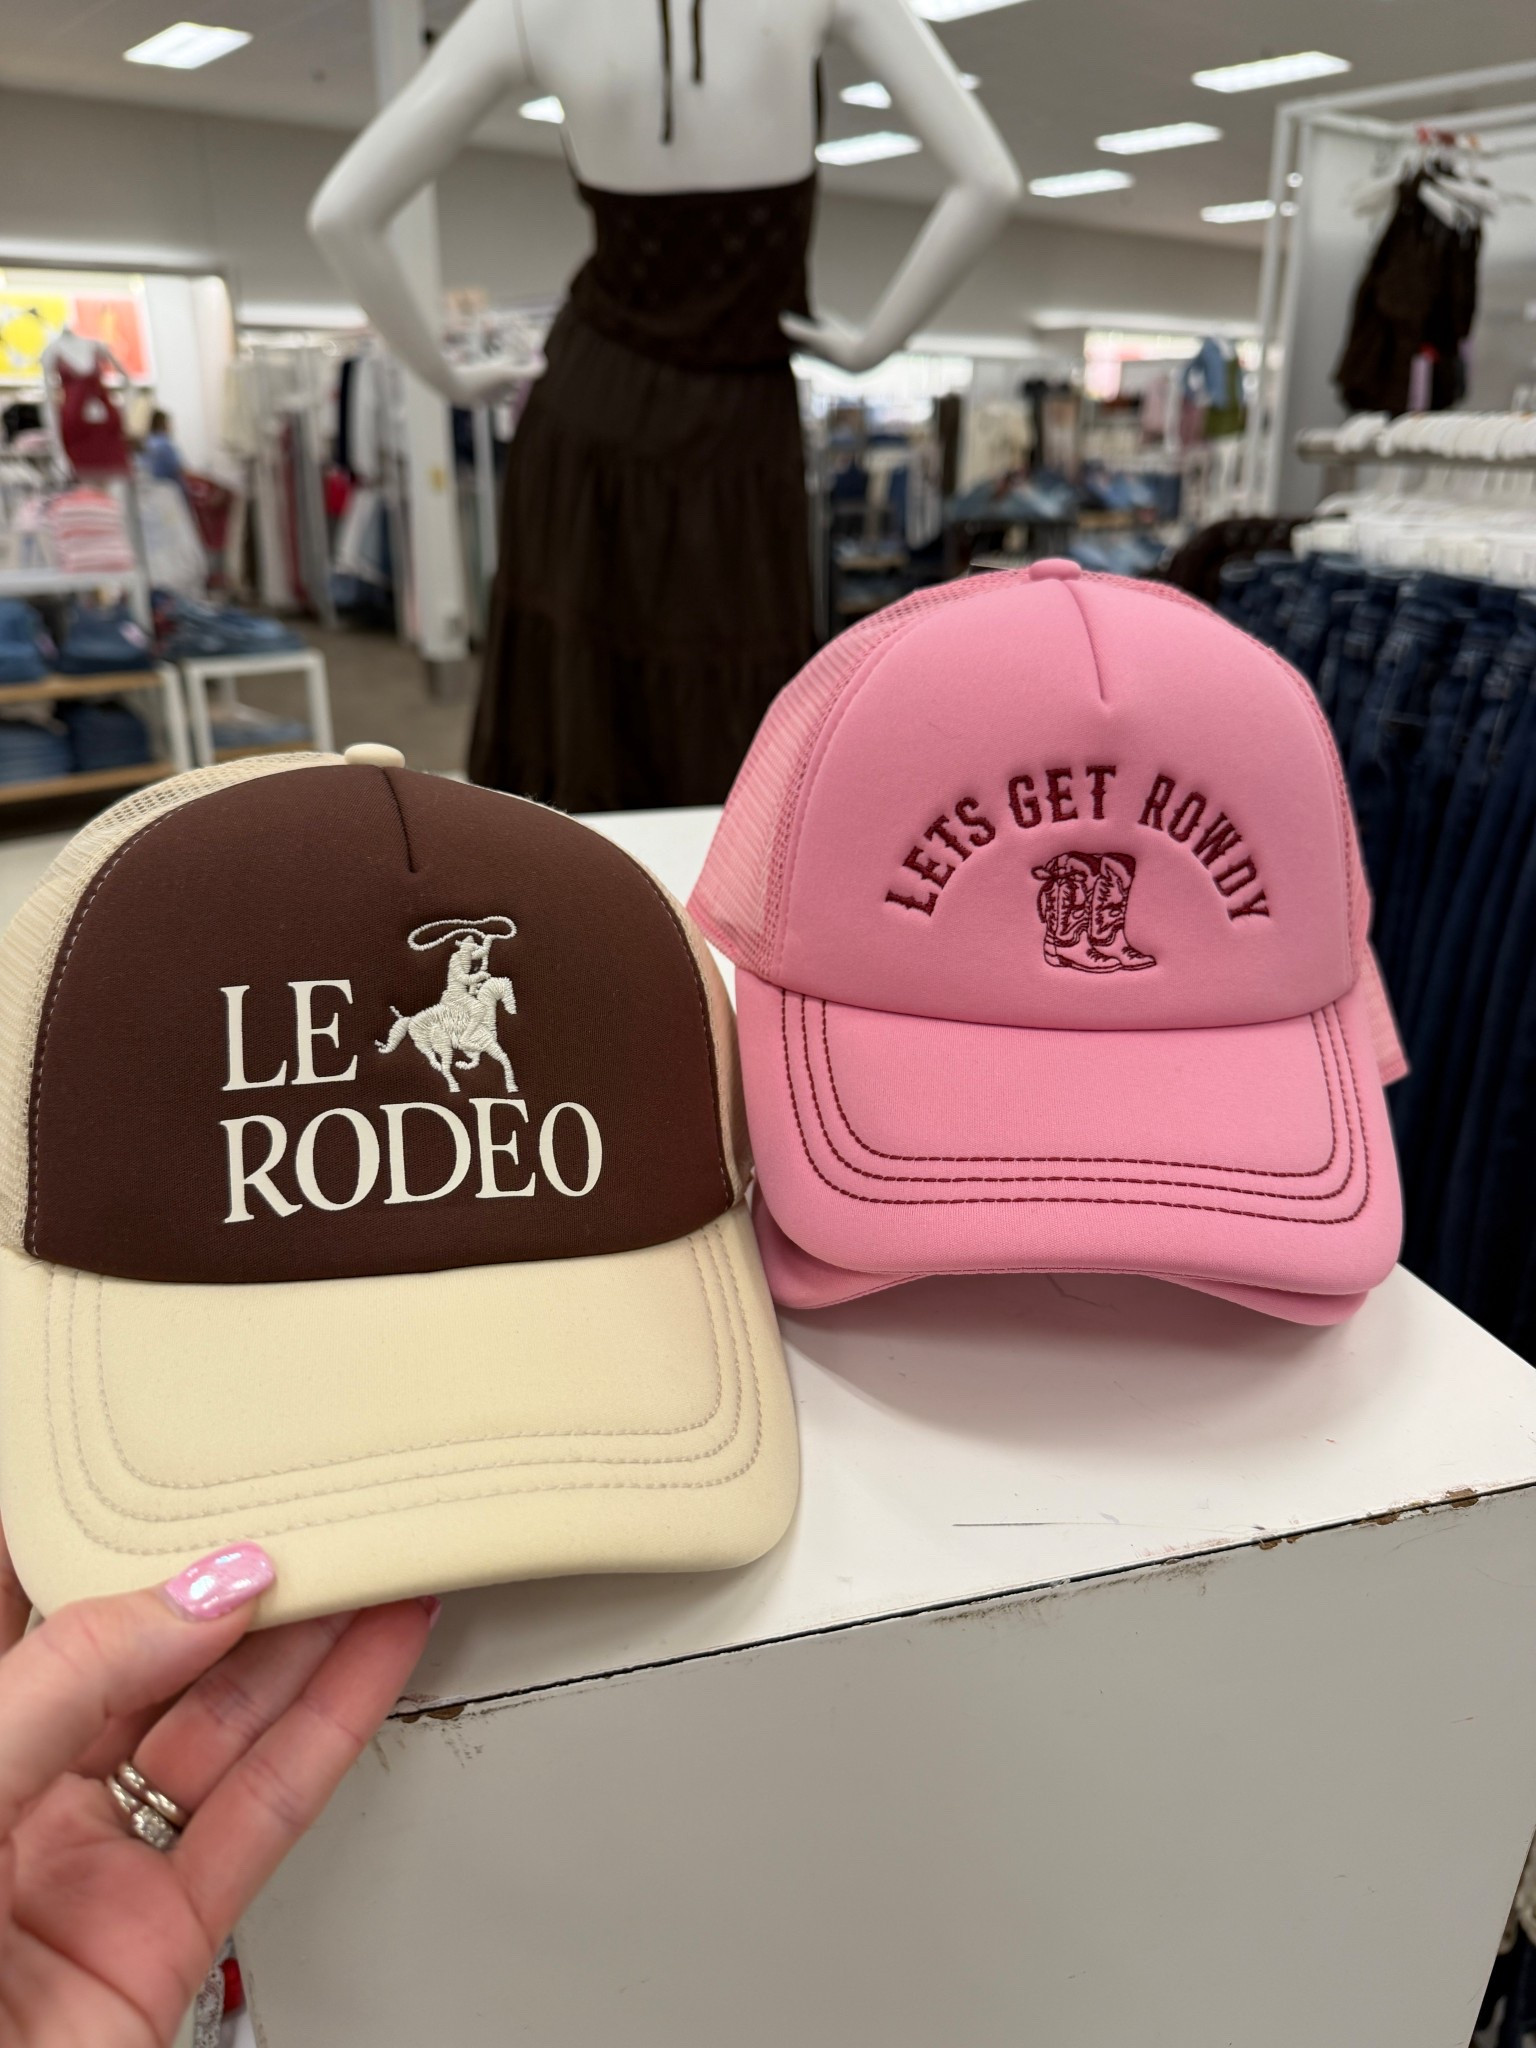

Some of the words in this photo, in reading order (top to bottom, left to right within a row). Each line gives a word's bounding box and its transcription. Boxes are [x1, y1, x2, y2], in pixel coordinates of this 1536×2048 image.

[885, 796, 996, 917] LETS
[1008, 765, 1116, 829] GET
[1138, 774, 1270, 921] ROWDY
[220, 979, 358, 1091] LE
[219, 1097, 603, 1224] RODEO
